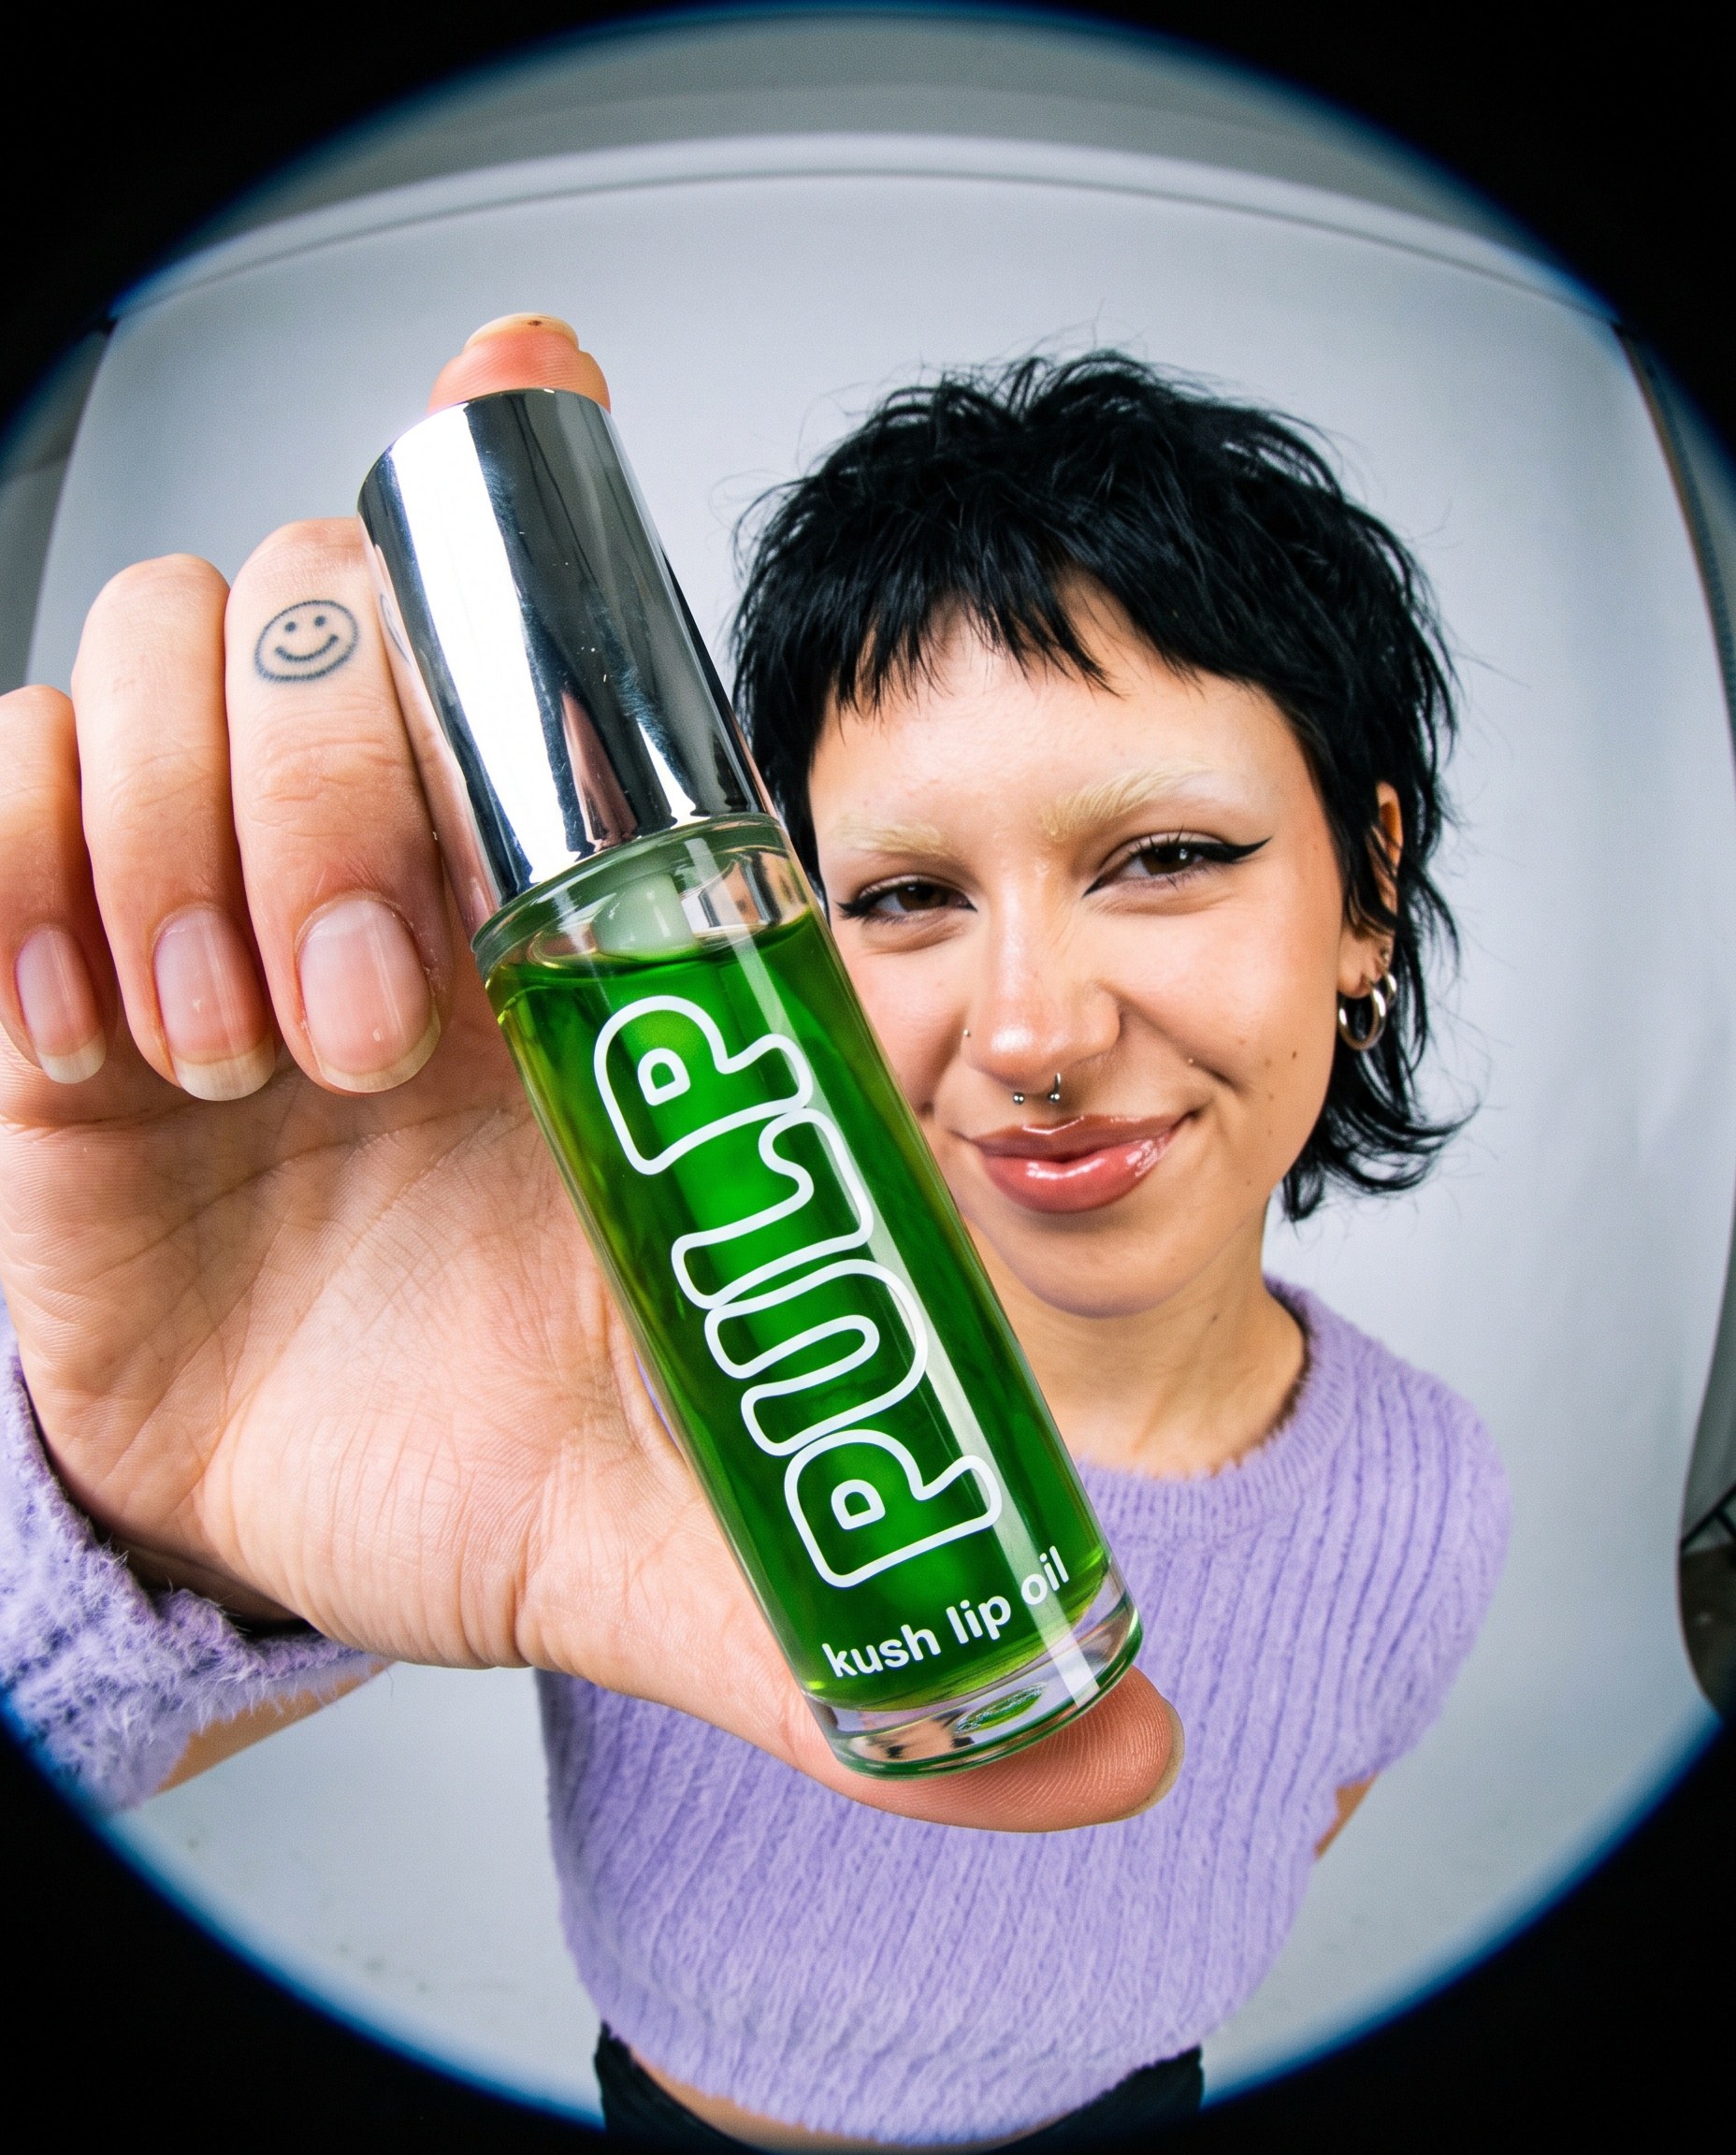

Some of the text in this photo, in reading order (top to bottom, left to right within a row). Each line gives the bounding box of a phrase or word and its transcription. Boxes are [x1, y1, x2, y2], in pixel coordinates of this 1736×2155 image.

[593, 994, 1003, 1588] PULP
[821, 1545, 1070, 1678] kush lip oil
